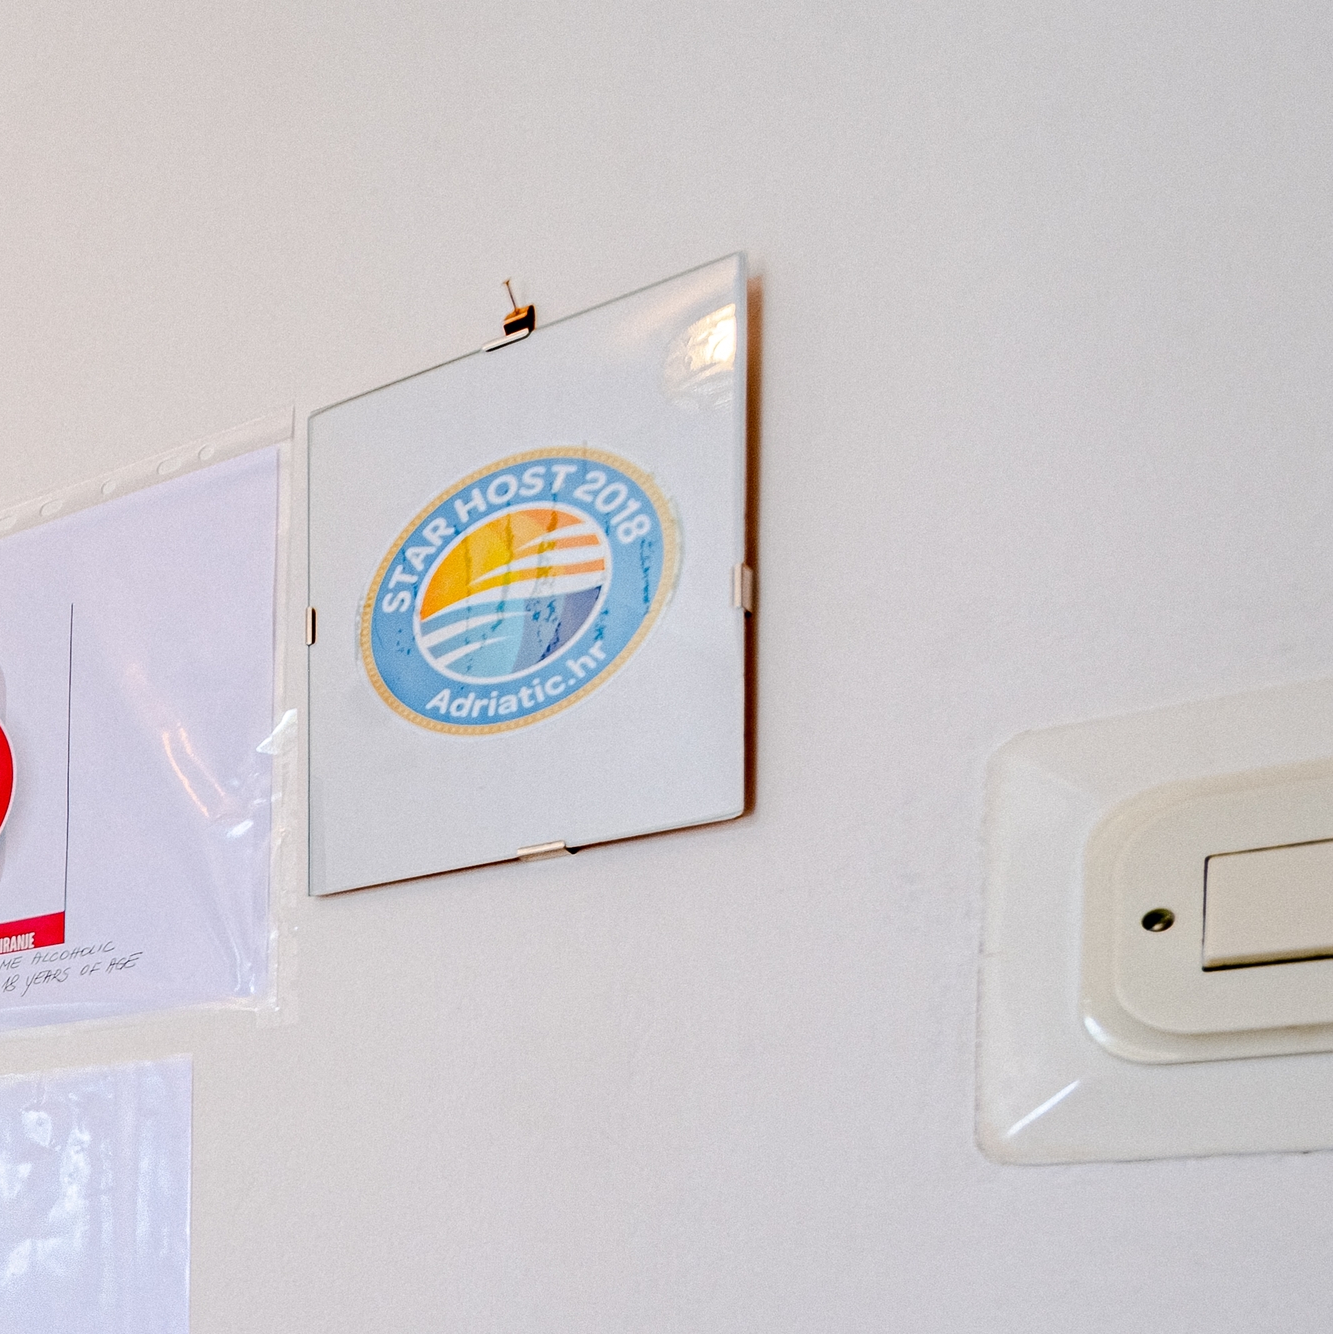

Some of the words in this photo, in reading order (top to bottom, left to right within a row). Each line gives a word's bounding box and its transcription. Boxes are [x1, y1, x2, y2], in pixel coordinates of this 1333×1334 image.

[381, 517, 456, 614] STAR
[454, 464, 578, 525] HOST
[572, 470, 653, 547] 2018
[425, 640, 609, 719] Adriatic.hr
[1, 974, 20, 993] 18
[21, 967, 71, 998] YEARS
[80, 962, 102, 976] OF
[105, 951, 145, 974] AGE
[31, 941, 116, 965] ALCOHOLIC
